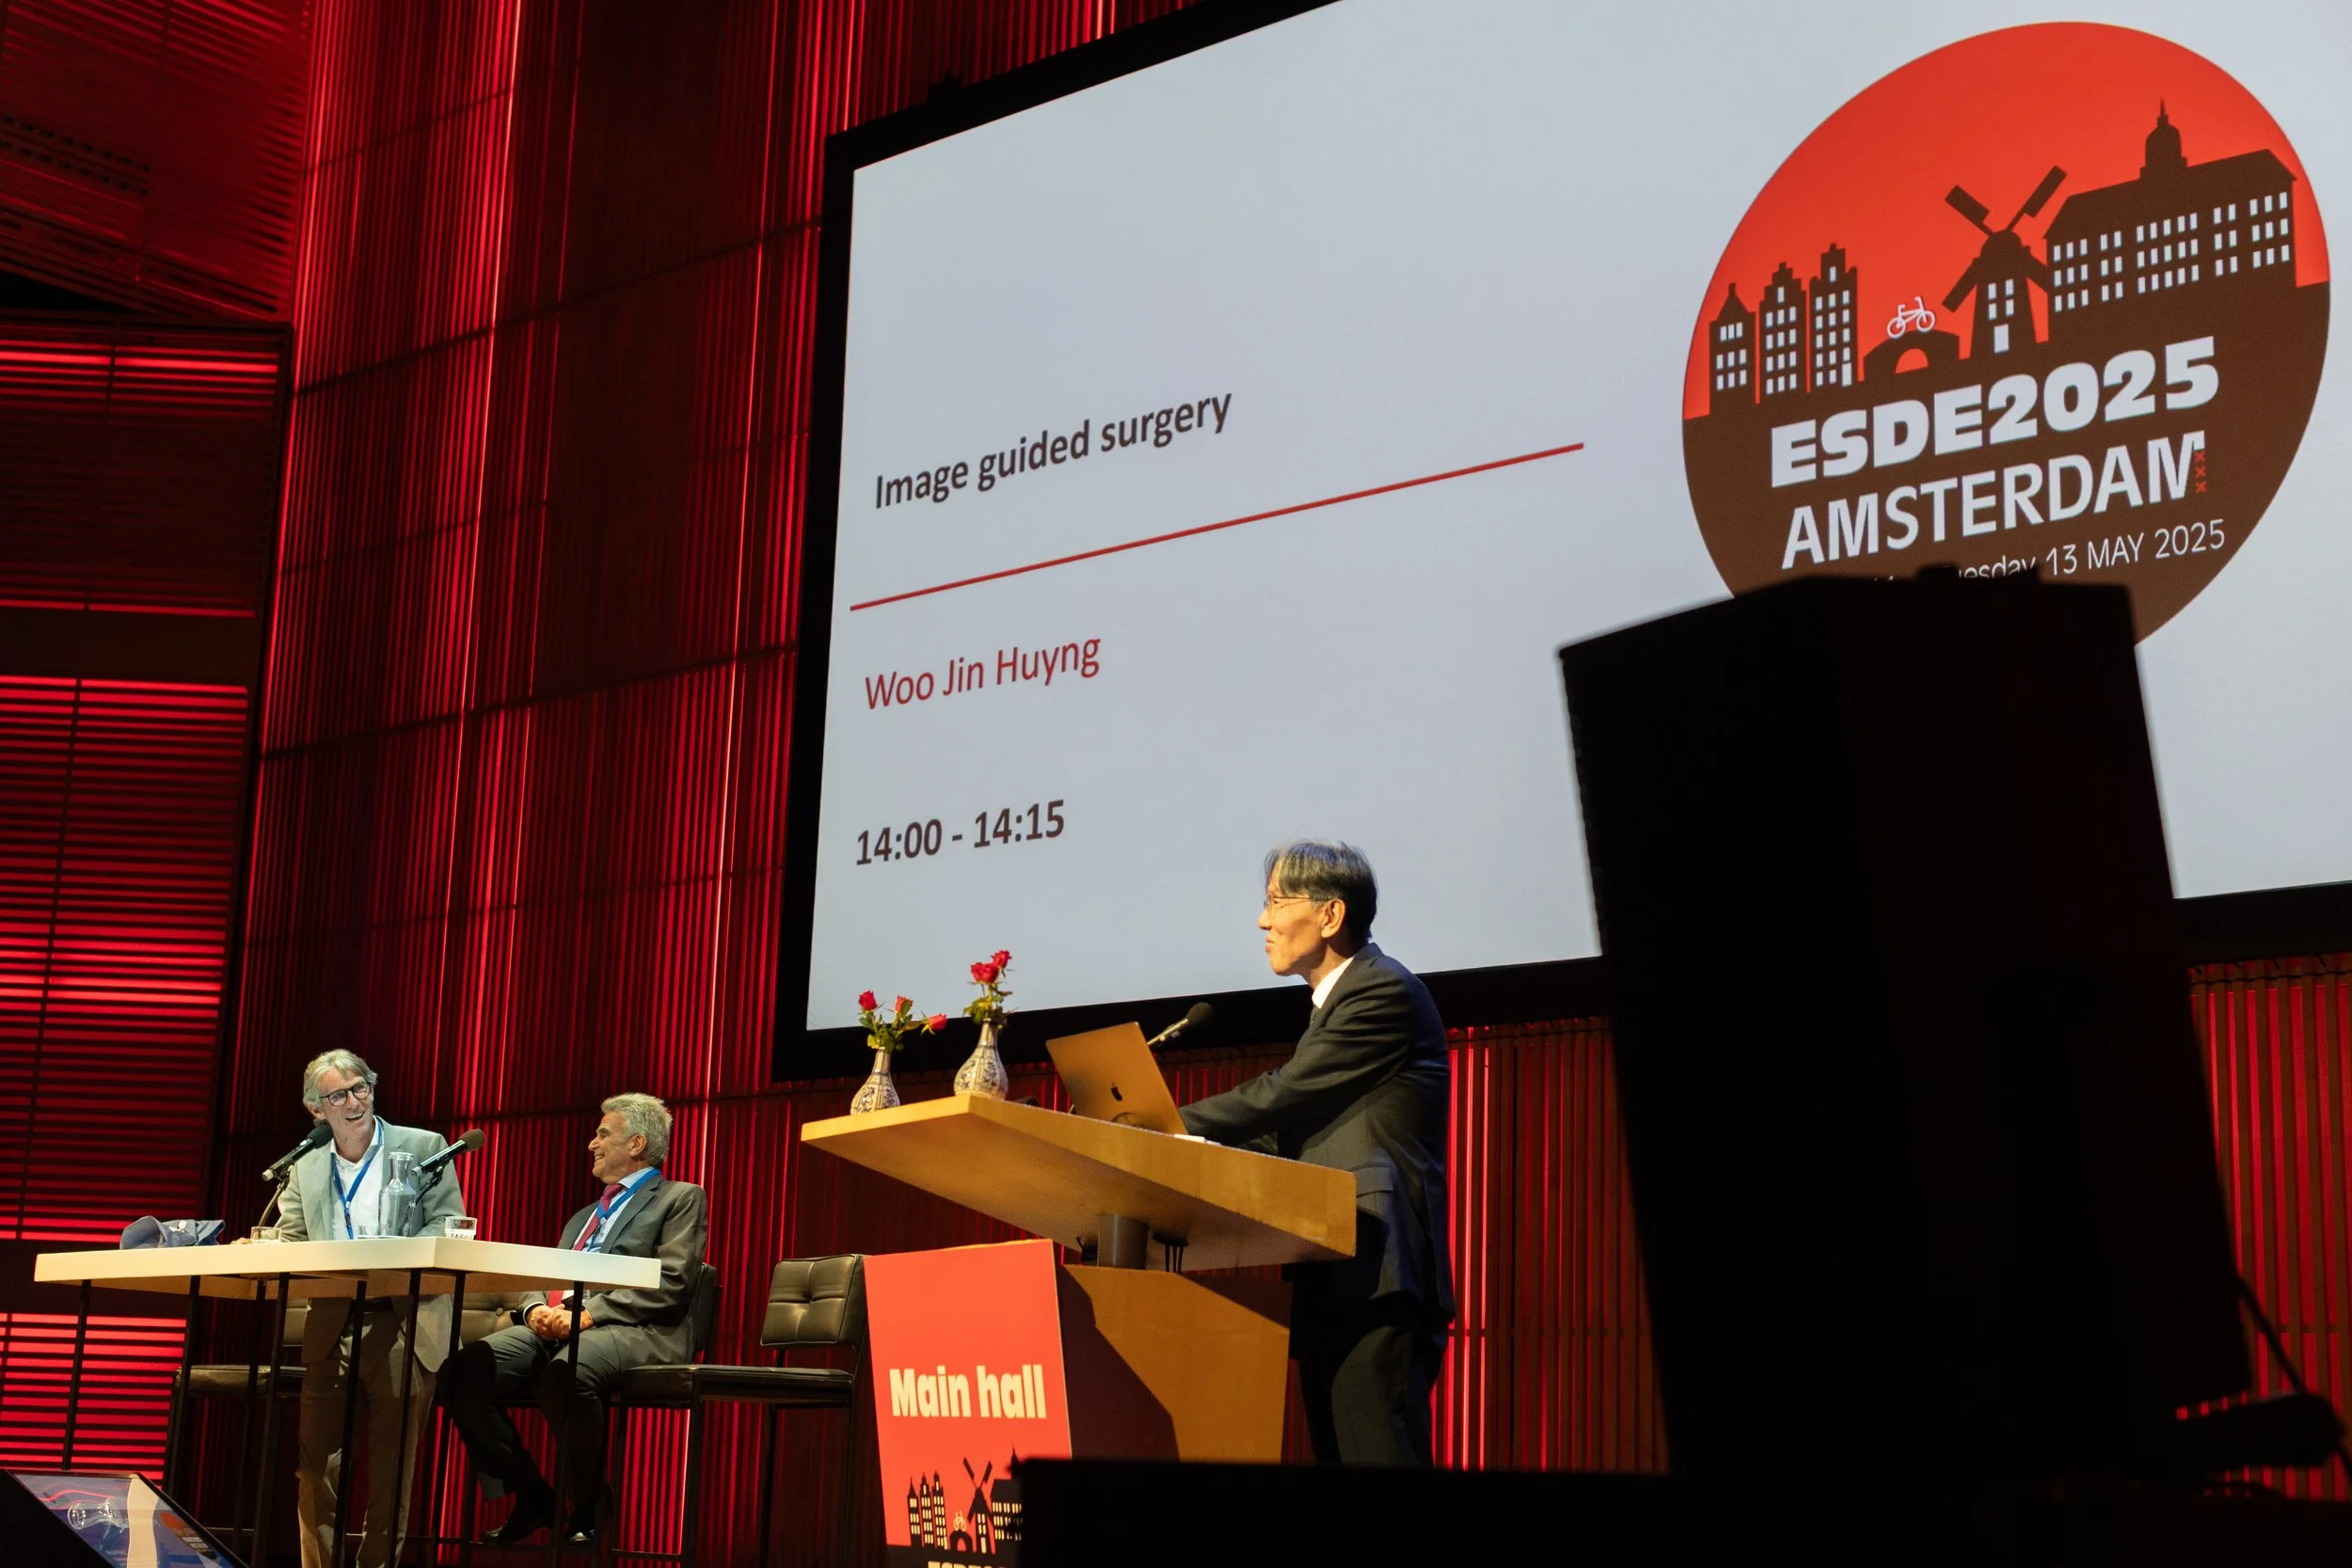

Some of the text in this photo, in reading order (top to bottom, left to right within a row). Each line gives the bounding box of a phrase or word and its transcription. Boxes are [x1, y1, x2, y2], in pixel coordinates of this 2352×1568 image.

[1771, 335, 2219, 488] ESDE2025
[875, 392, 1232, 509] Image guided surgery
[1781, 430, 2206, 570] AMSTERDAM
[2045, 544, 2078, 576] 13
[2087, 531, 2145, 570] MAY
[2154, 518, 2226, 559] 2025
[865, 638, 1102, 710] Woo Jin Huyng
[856, 818, 943, 866] 14:00
[974, 799, 1065, 848] 14:15
[889, 1364, 1047, 1419] Main hall
